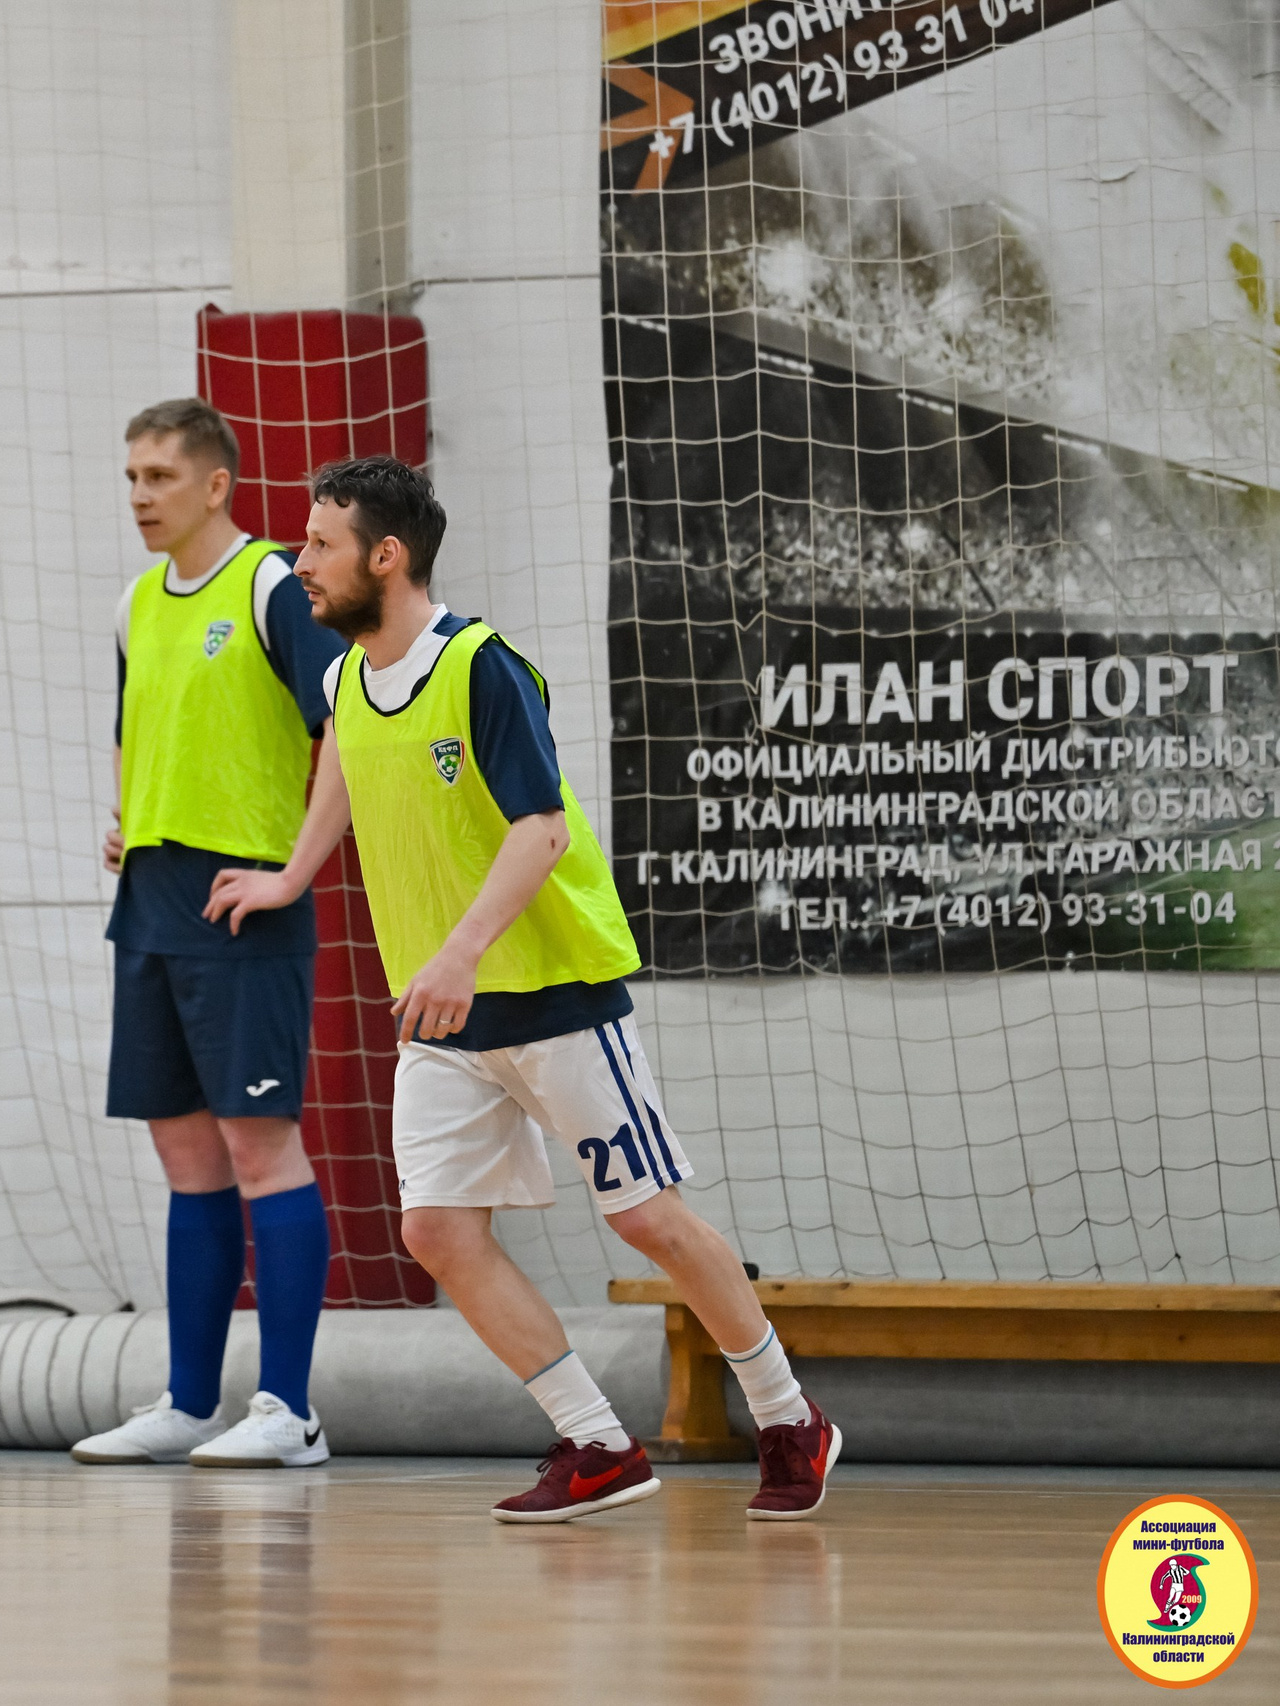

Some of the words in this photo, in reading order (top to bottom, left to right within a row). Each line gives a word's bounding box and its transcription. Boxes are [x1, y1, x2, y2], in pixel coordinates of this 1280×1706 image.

[649, 112, 695, 158] +7
[710, 53, 847, 147] (4012)
[853, 31, 909, 80] 93
[915, 4, 968, 55] 31
[760, 659, 965, 728] ИЛАН
[988, 654, 1239, 721] СПОРТ
[686, 731, 991, 785] ОФИЦИАЛЬНЫЙ
[1001, 733, 1280, 780] ДИСТРИБЬЮТ
[699, 802, 722, 832] В
[733, 780, 1119, 831] КАЛИНИНГРАДСКОЙ
[637, 851, 661, 885] Г.
[671, 843, 961, 884] КАЛИНИНГРАД,
[1046, 838, 1262, 875] ГАРАЖНАЯ
[881, 895, 922, 929] +7
[934, 891, 1052, 937] (4012)
[1062, 890, 1237, 927] 93-31-04
[577, 1122, 648, 1192] 21
